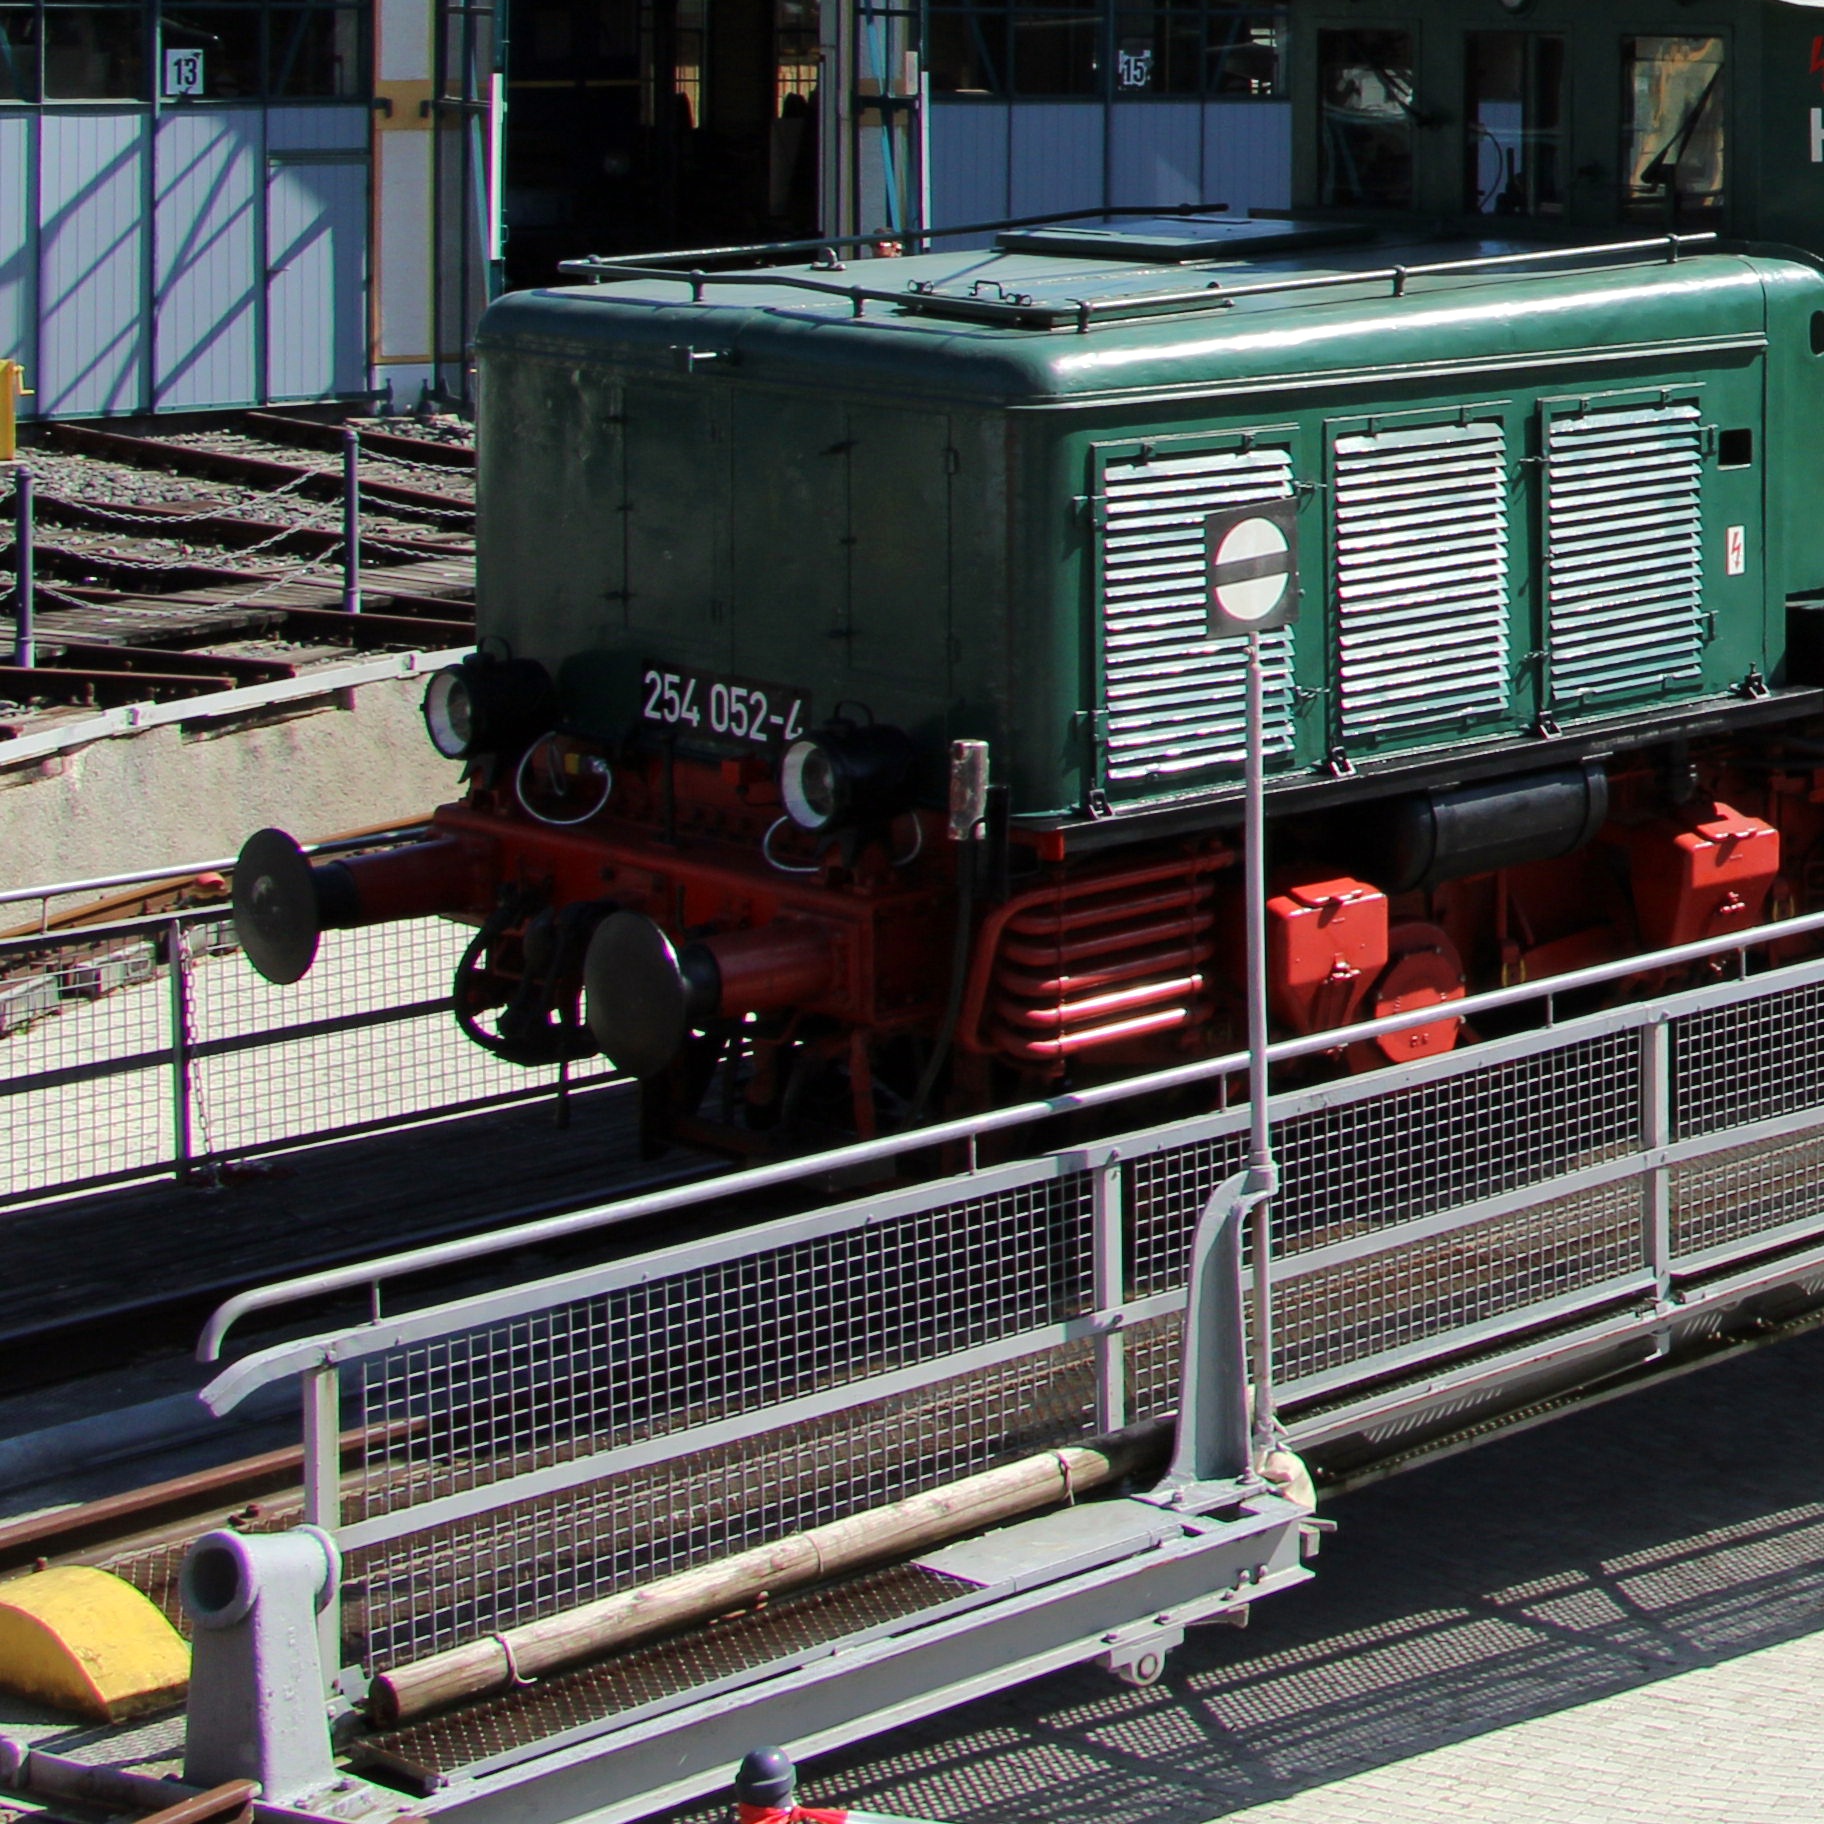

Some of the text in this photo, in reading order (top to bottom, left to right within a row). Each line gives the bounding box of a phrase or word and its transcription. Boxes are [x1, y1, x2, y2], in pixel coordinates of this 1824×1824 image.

[173, 58, 198, 85] 13
[1123, 58, 1145, 83] 15
[643, 670, 700, 727] 254
